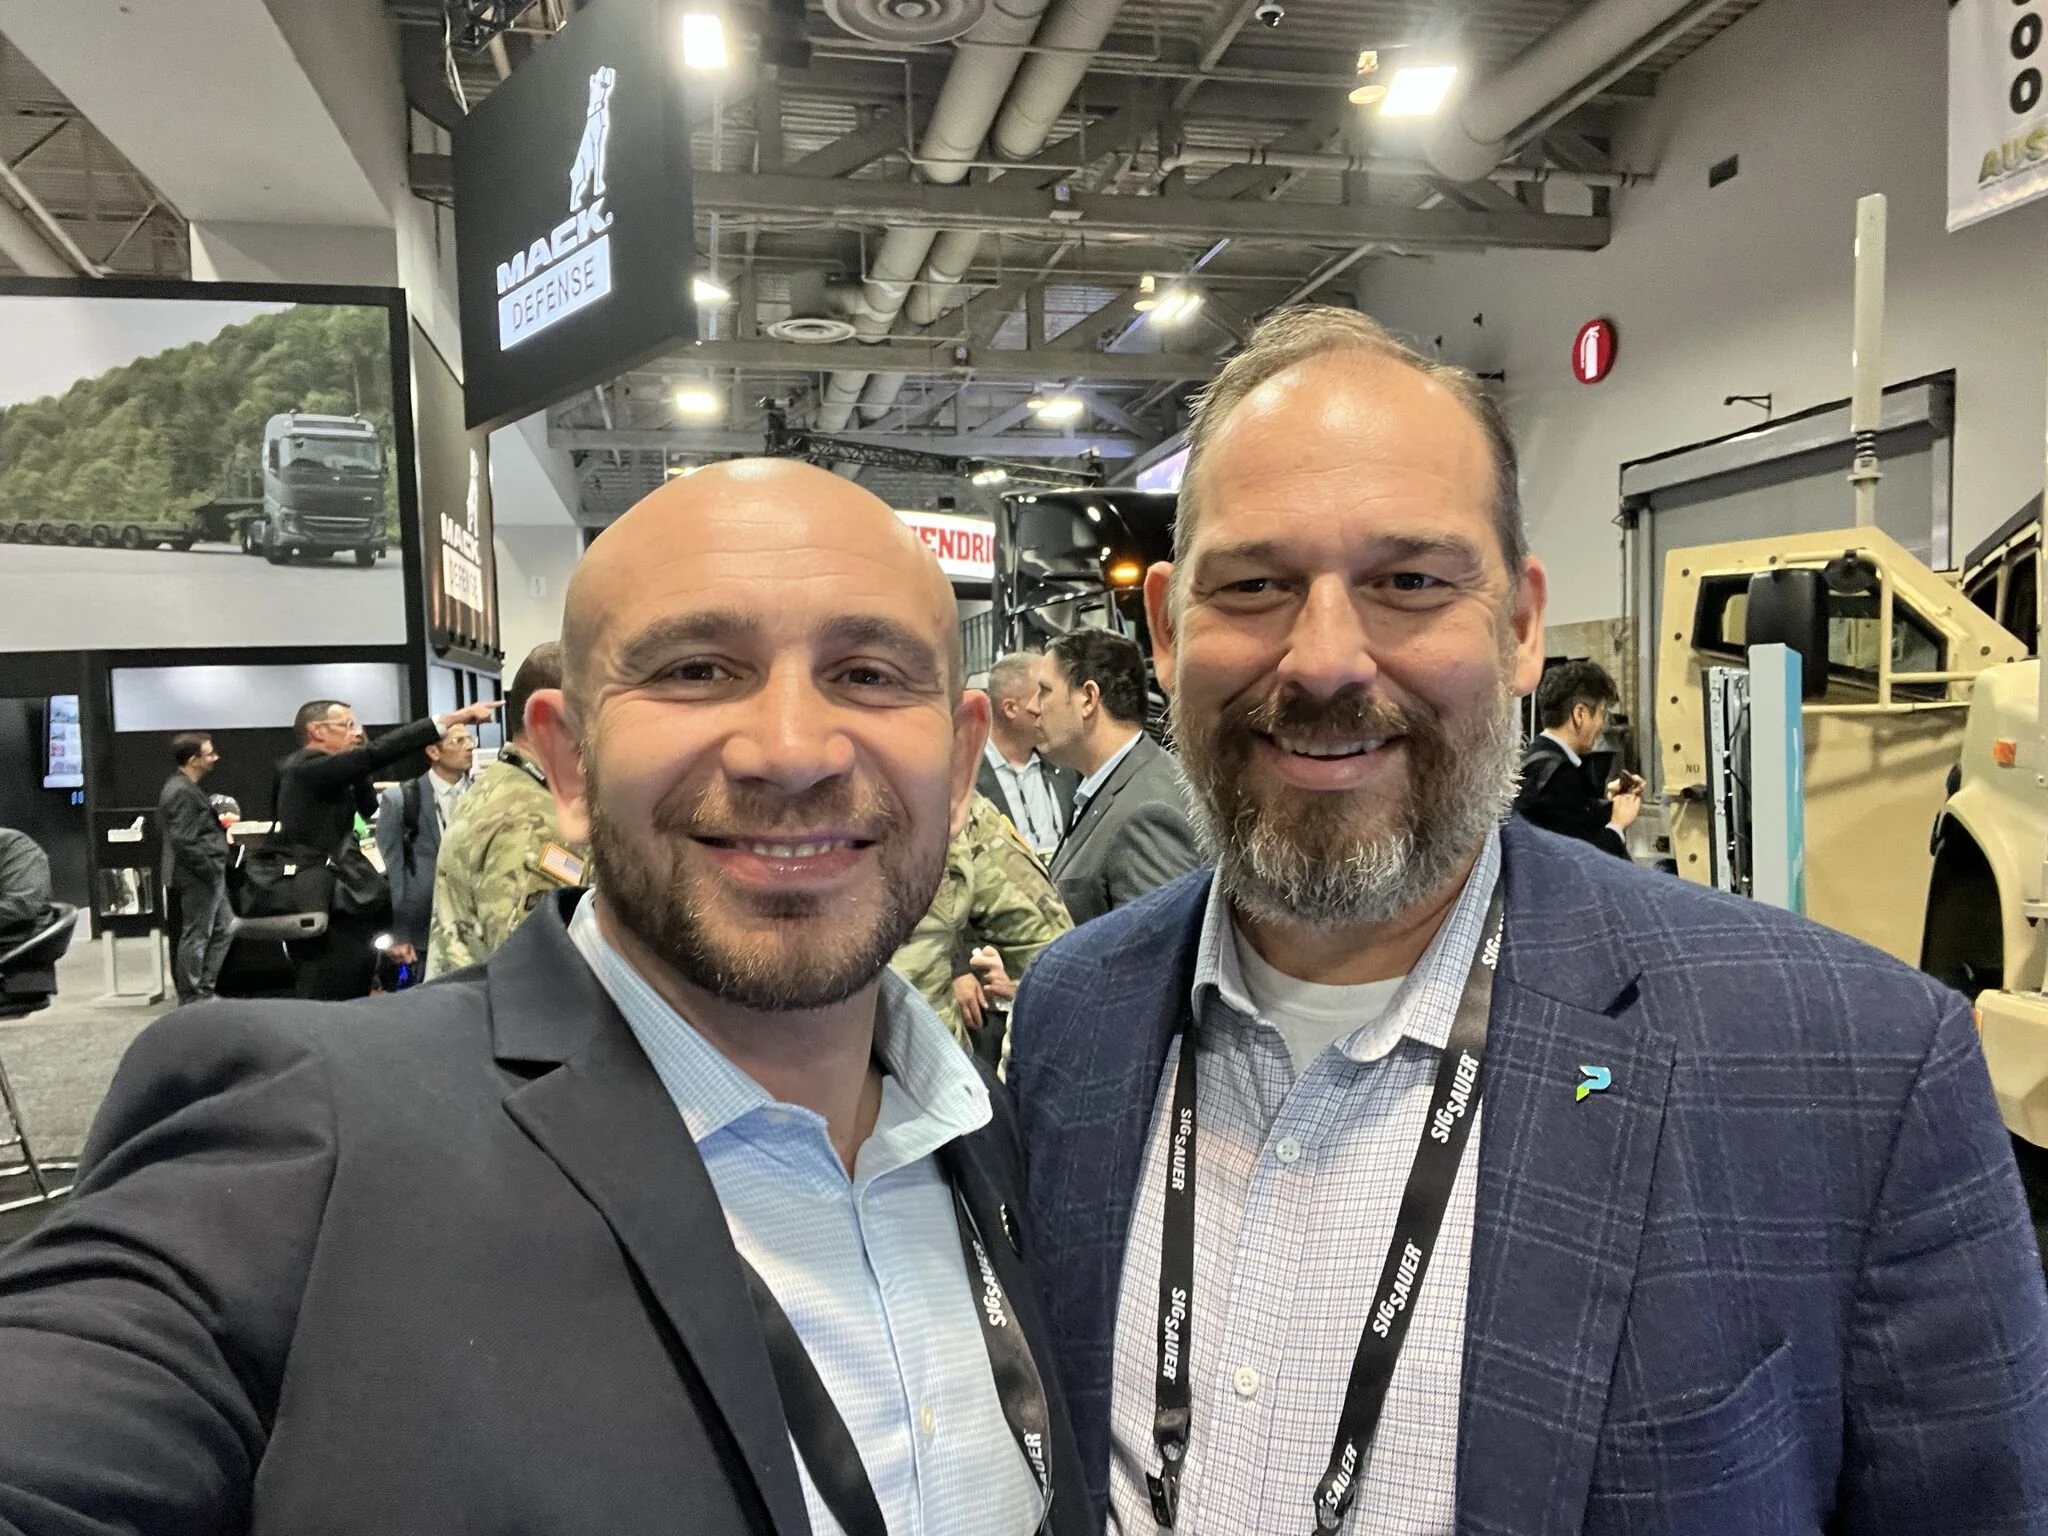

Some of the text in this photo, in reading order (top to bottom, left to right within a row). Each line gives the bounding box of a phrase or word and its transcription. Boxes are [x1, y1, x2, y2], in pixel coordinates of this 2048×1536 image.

[496, 197, 607, 295] MACK
[512, 256, 594, 332] DEFENSE
[440, 512, 482, 566] MACK
[909, 525, 992, 564] ENDRI
